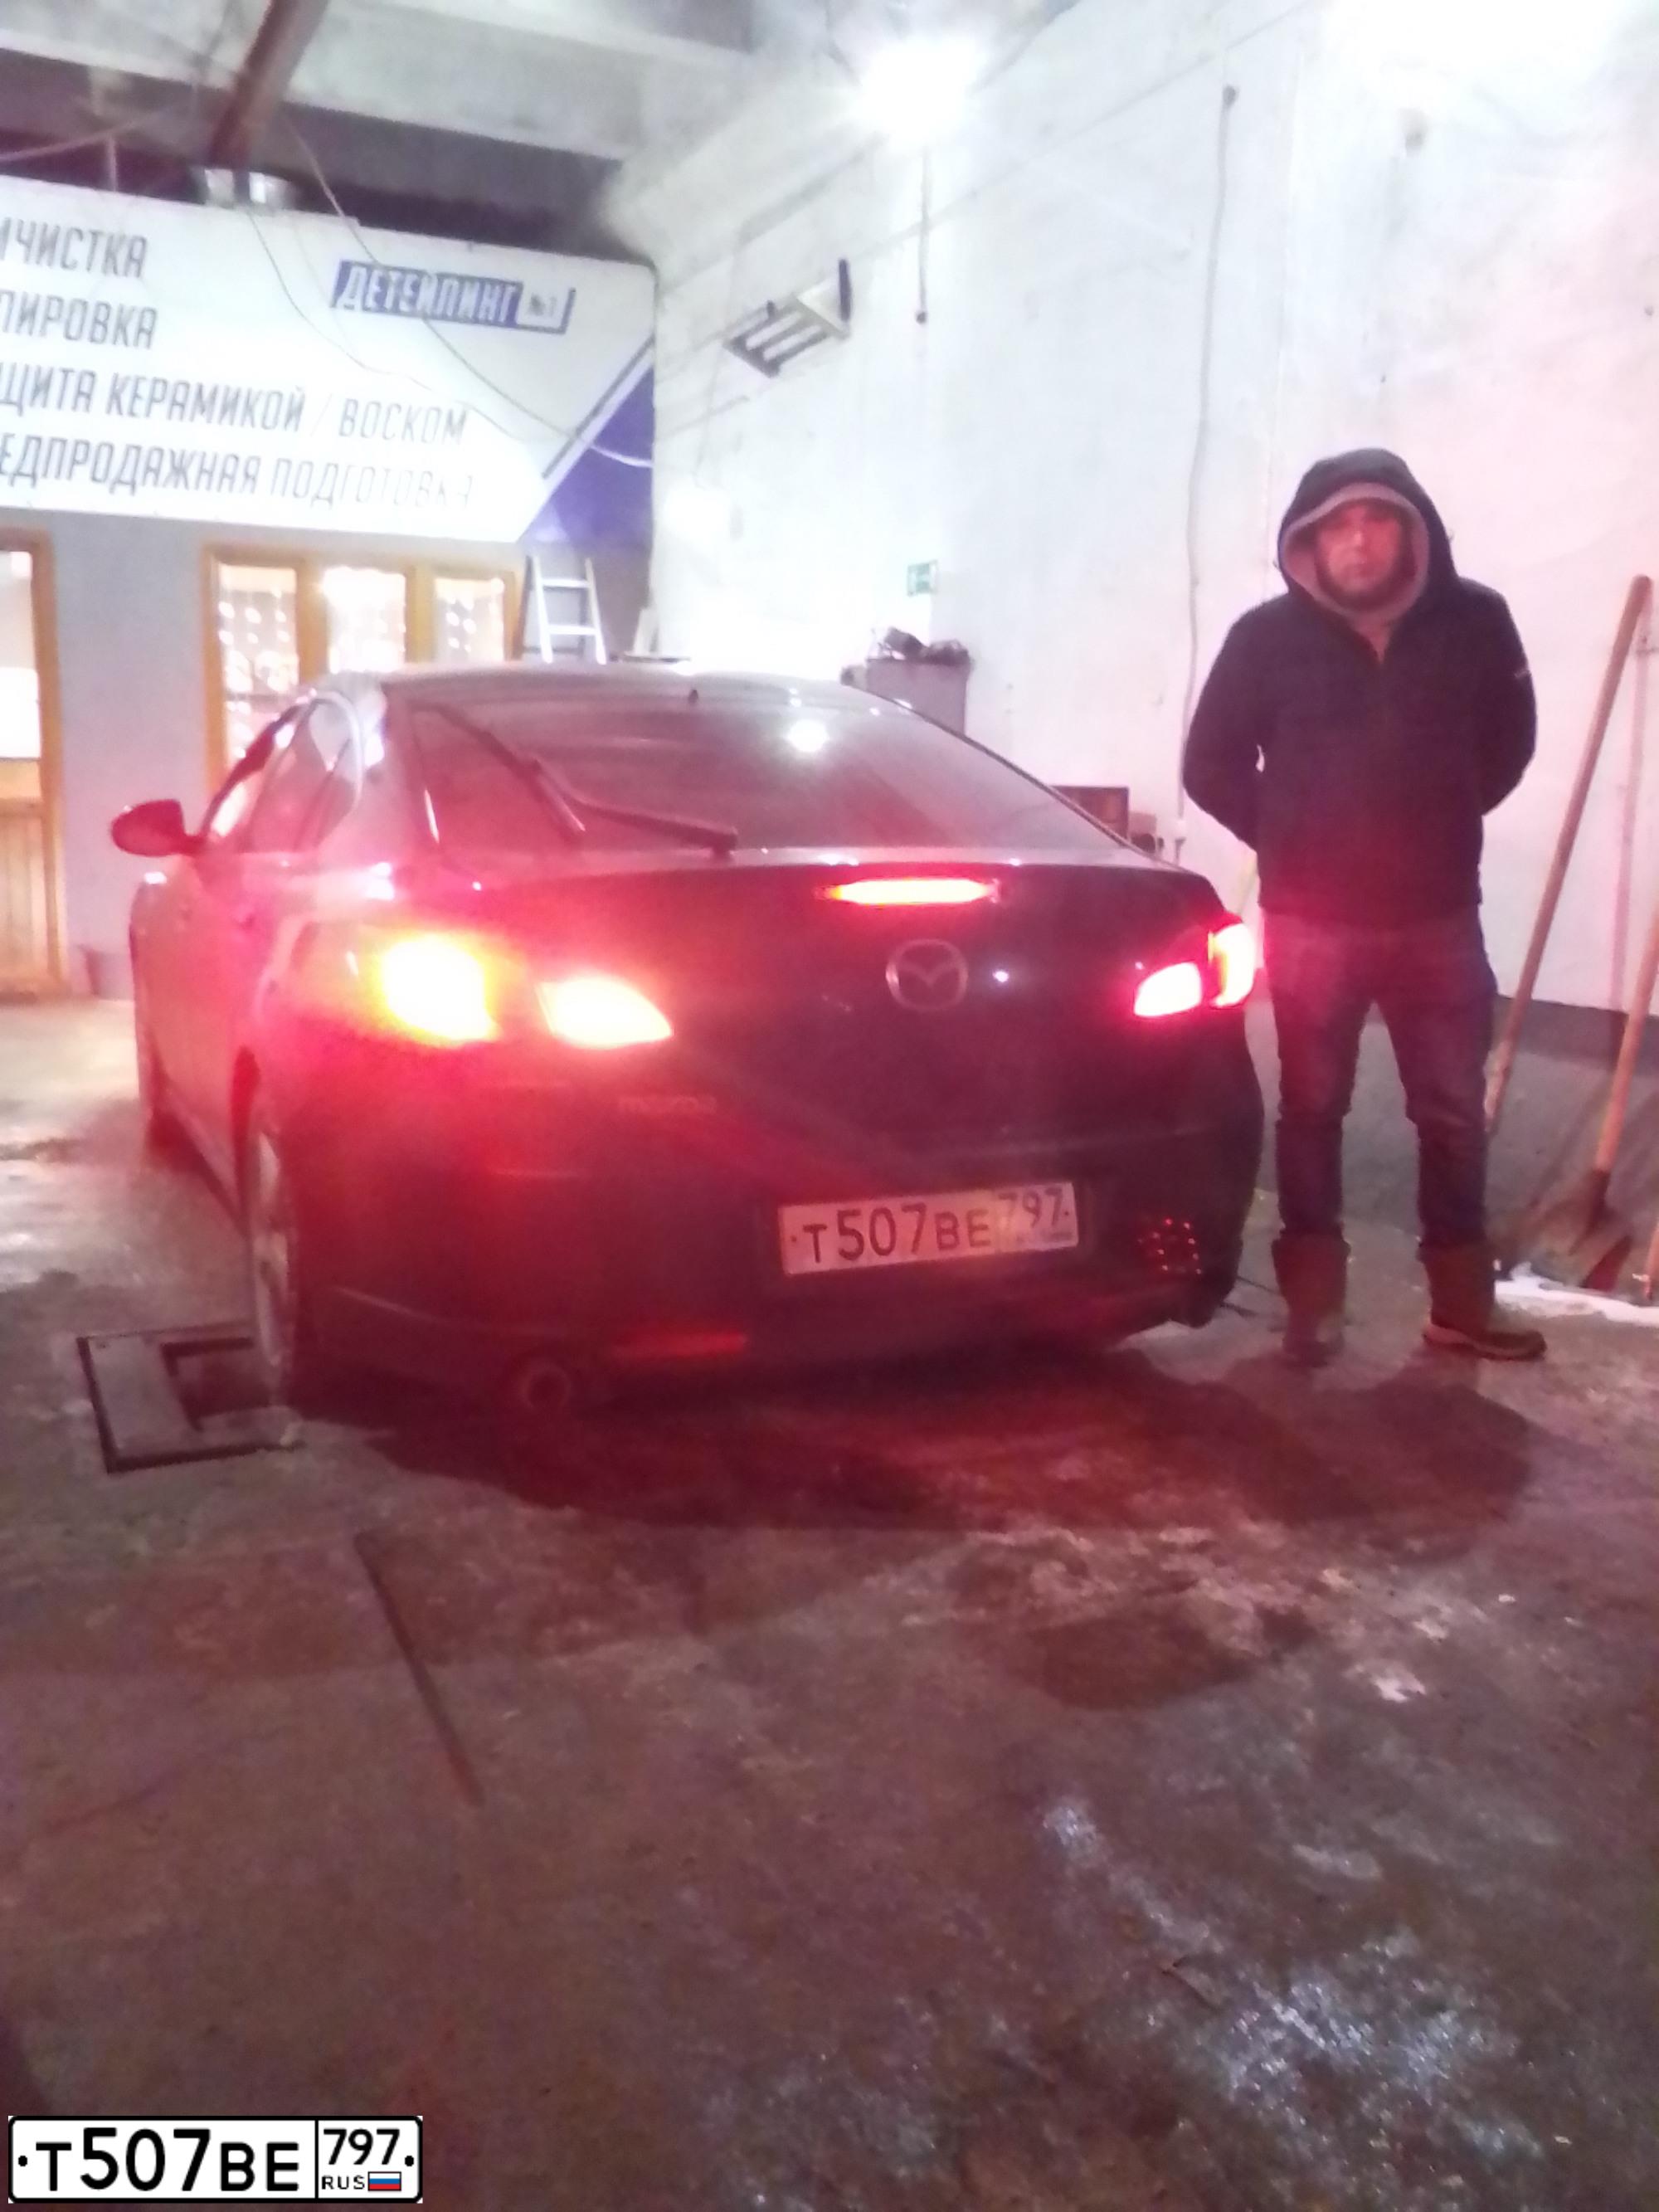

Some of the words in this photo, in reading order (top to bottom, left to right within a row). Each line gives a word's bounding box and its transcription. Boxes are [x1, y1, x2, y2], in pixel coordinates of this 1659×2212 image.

[336, 265, 518, 323] ДЕТЕЙЛИНГ
[105, 373, 306, 432] КЕРАМИКОЙ
[338, 397, 467, 444] ВОСКОМ
